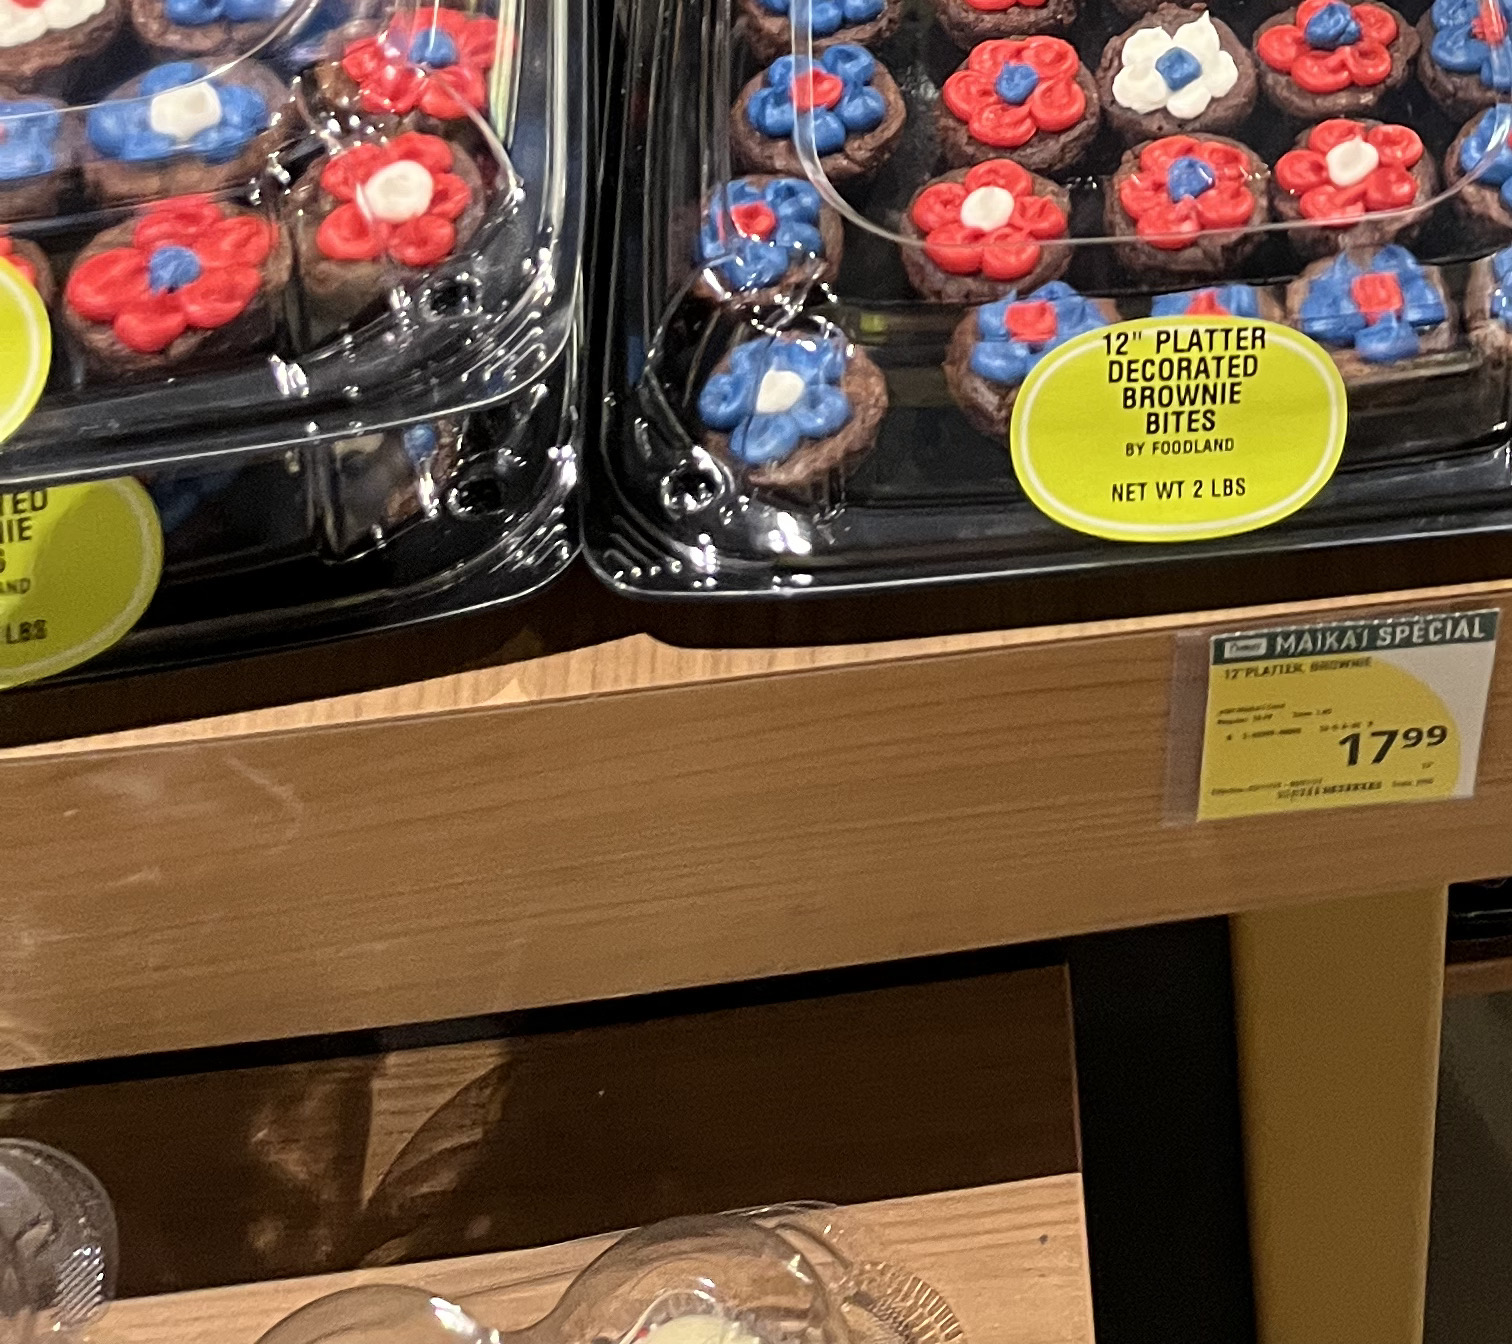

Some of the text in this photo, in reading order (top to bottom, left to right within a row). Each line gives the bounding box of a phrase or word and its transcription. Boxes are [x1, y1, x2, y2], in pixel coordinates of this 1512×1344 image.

[1102, 326, 1266, 356] 12" PLATTER
[1108, 354, 1259, 383] DECORATED
[1122, 381, 1243, 409] BROWNIE
[1145, 409, 1216, 435] BITES
[1125, 437, 1235, 456] BY FOODLAND
[1111, 477, 1246, 503] NET WT 2 LBS
[6, 619, 48, 645] LBS
[1375, 616, 1485, 648] SPECIAL
